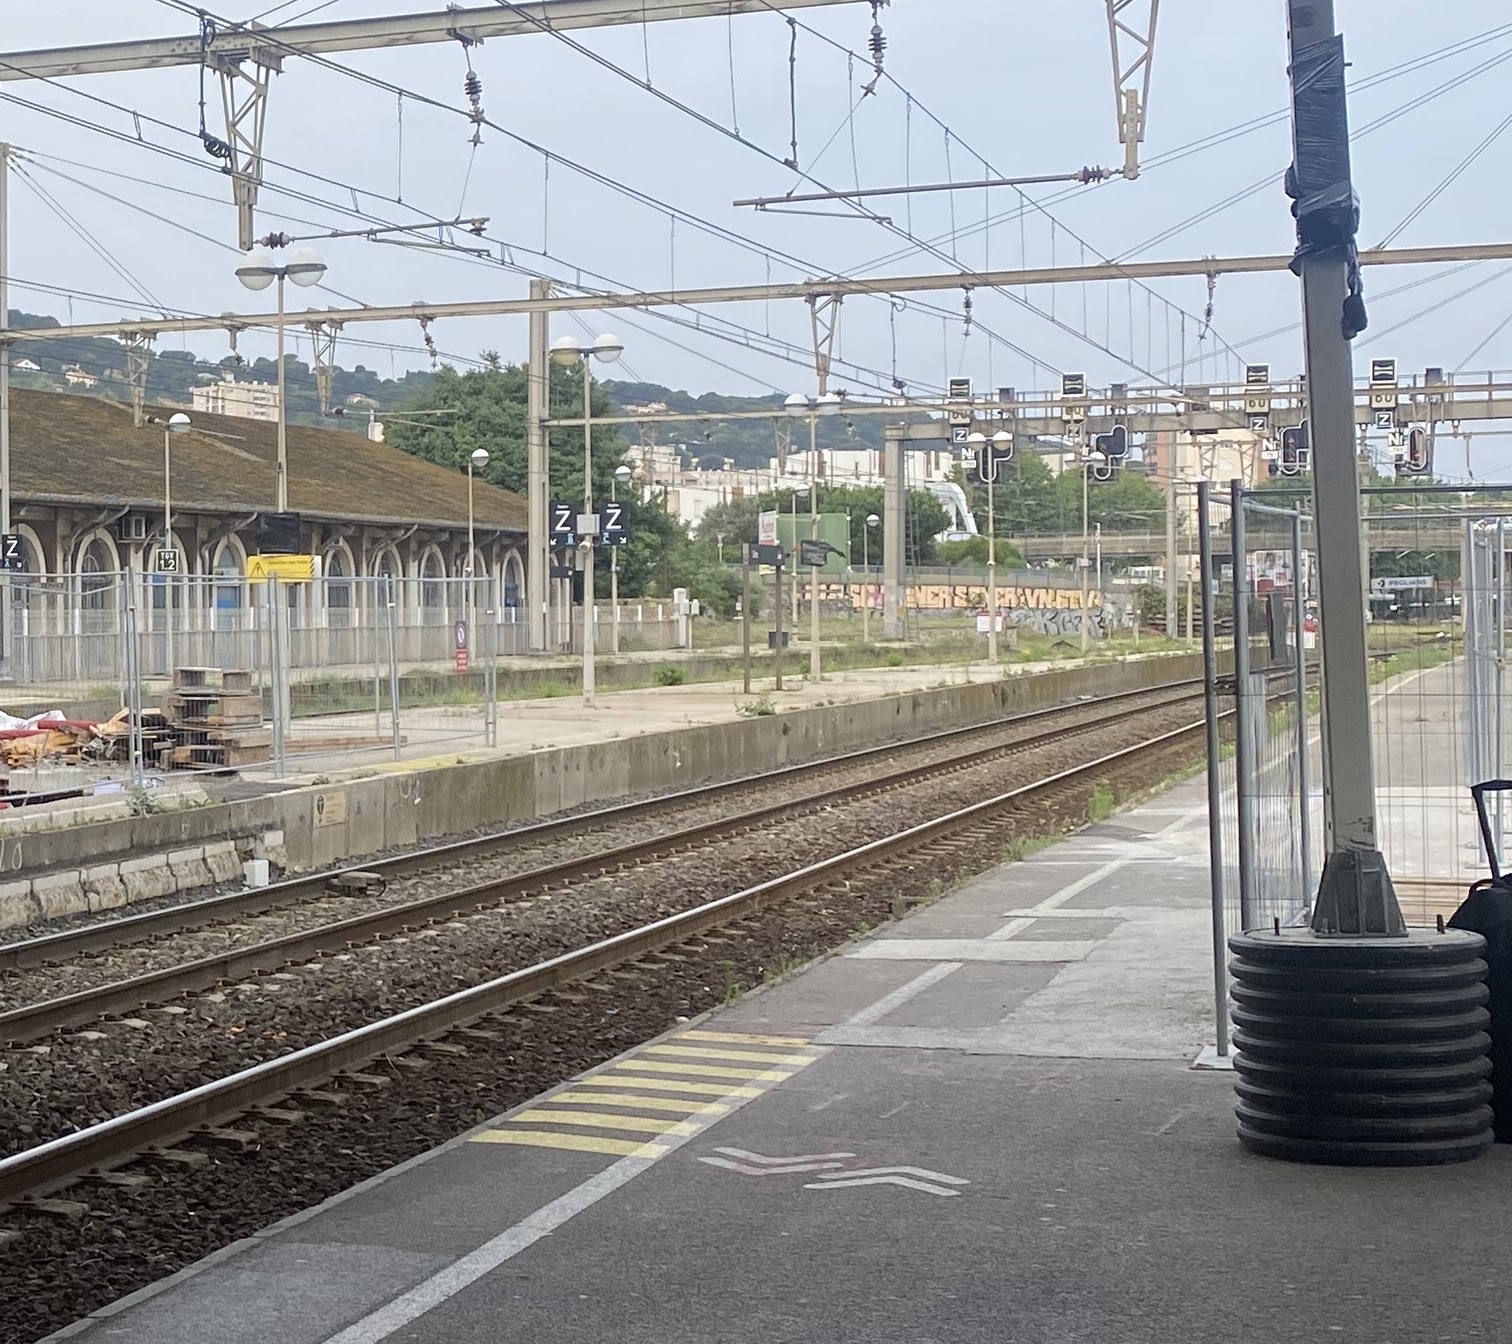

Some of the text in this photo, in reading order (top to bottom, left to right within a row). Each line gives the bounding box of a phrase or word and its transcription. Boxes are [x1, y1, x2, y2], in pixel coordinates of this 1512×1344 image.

[555, 510, 571, 531] Z
[605, 508, 622, 530] Z
[6, 539, 19, 557] Z
